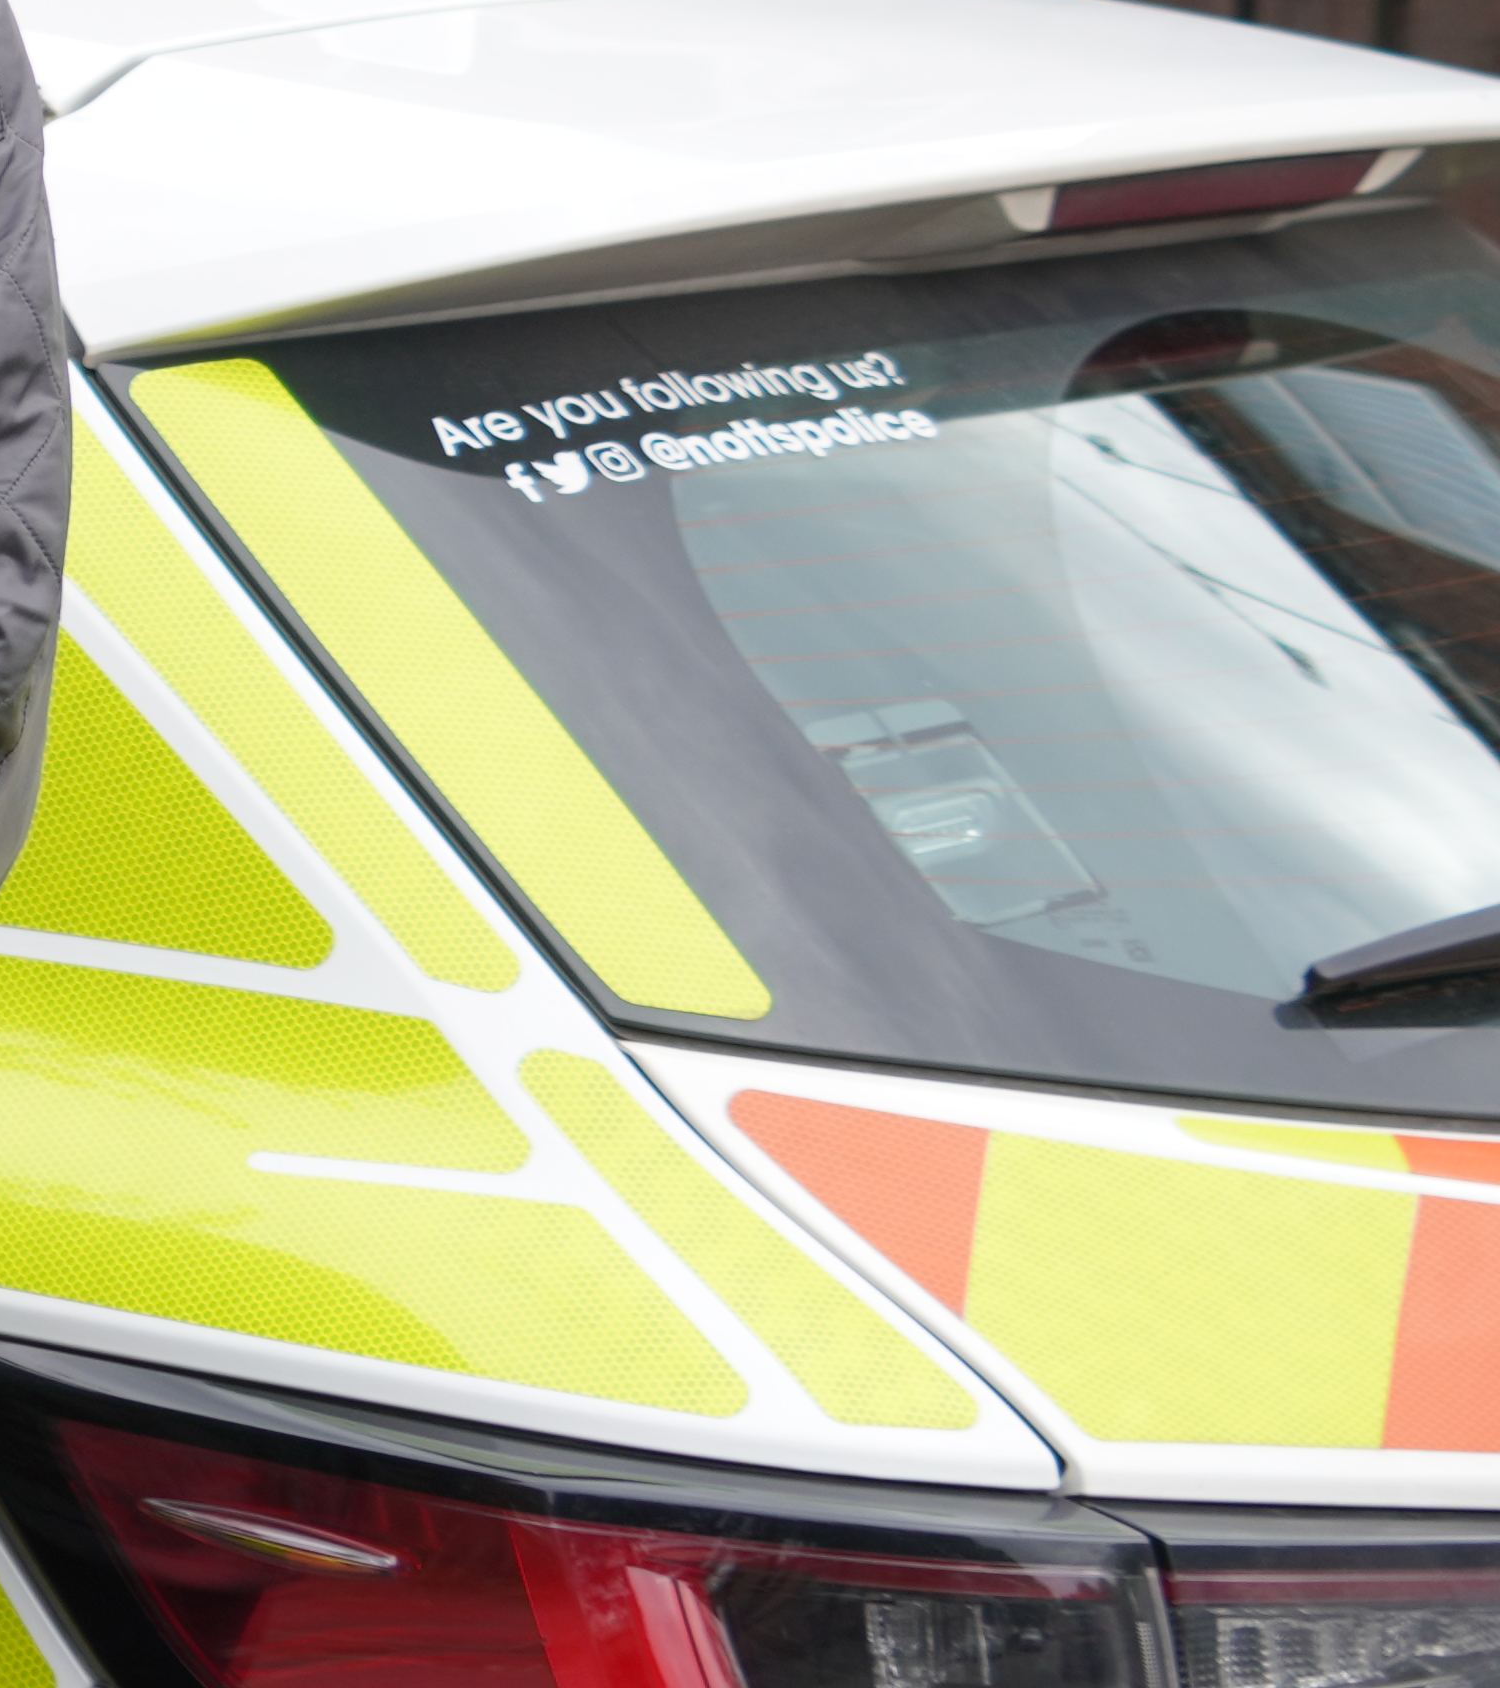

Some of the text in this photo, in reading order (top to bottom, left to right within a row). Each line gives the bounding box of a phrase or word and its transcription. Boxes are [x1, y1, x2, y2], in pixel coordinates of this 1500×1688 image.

[431, 351, 905, 457] Are you following us?
[639, 407, 940, 471] @nottspolice
